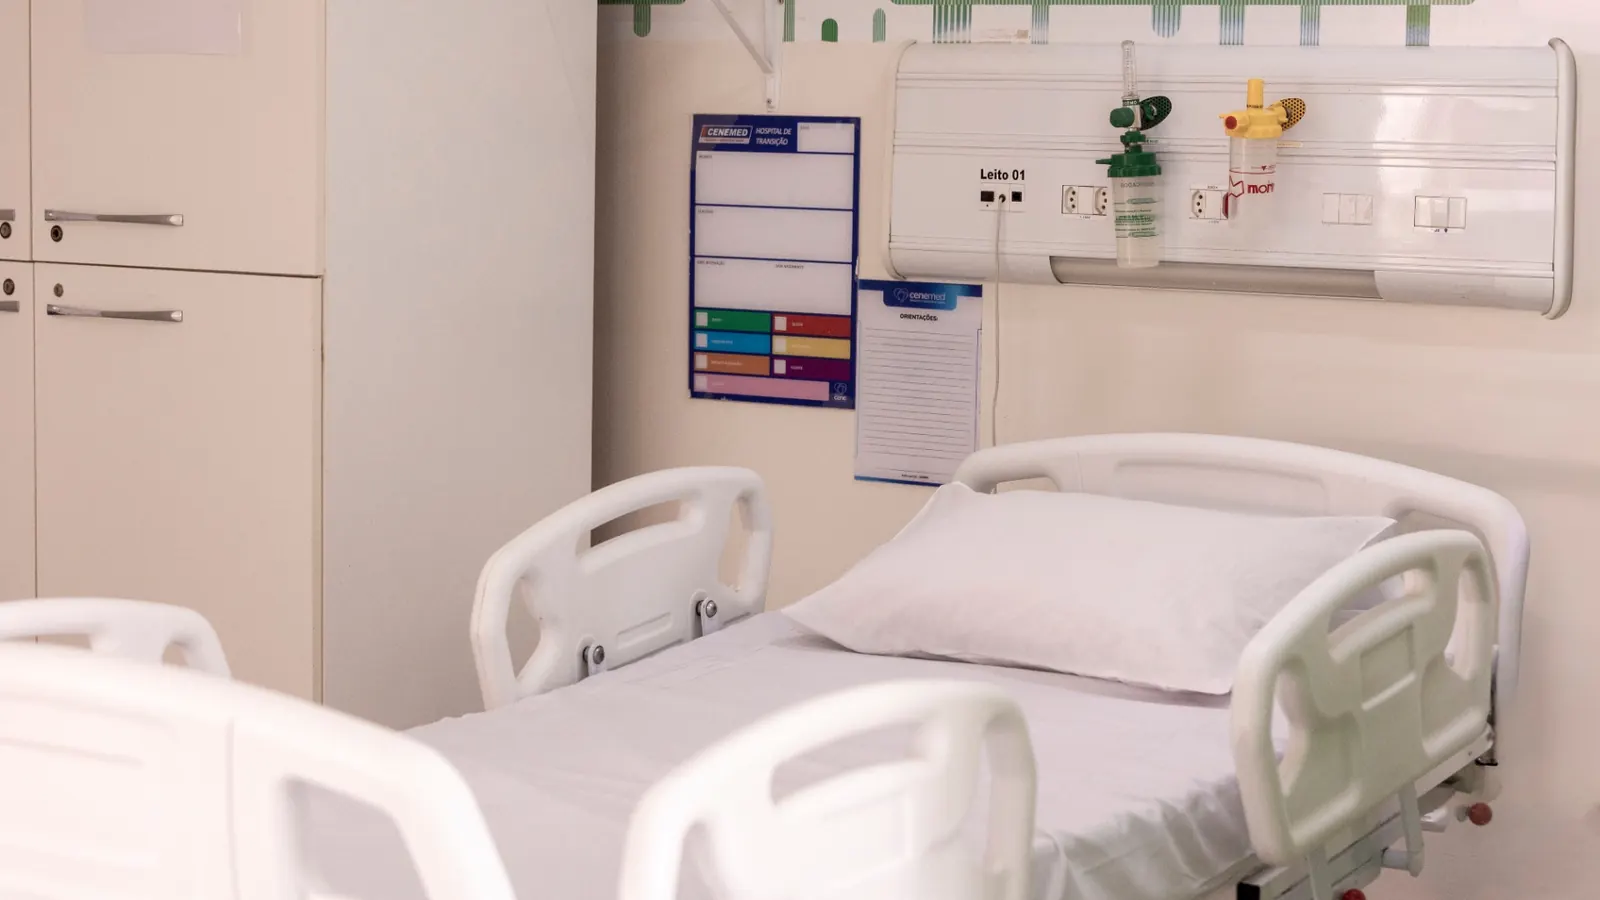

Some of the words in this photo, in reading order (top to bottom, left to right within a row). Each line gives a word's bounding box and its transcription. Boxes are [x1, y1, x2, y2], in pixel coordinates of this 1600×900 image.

[707, 127, 748, 137] CENEMED
[755, 127, 783, 135] HOSPITAL
[783, 128, 792, 136] DE
[755, 137, 788, 146] TRANSIÇÃO
[980, 168, 1009, 180] Leito
[1011, 169, 1025, 180] 01
[909, 291, 946, 301] cenemed
